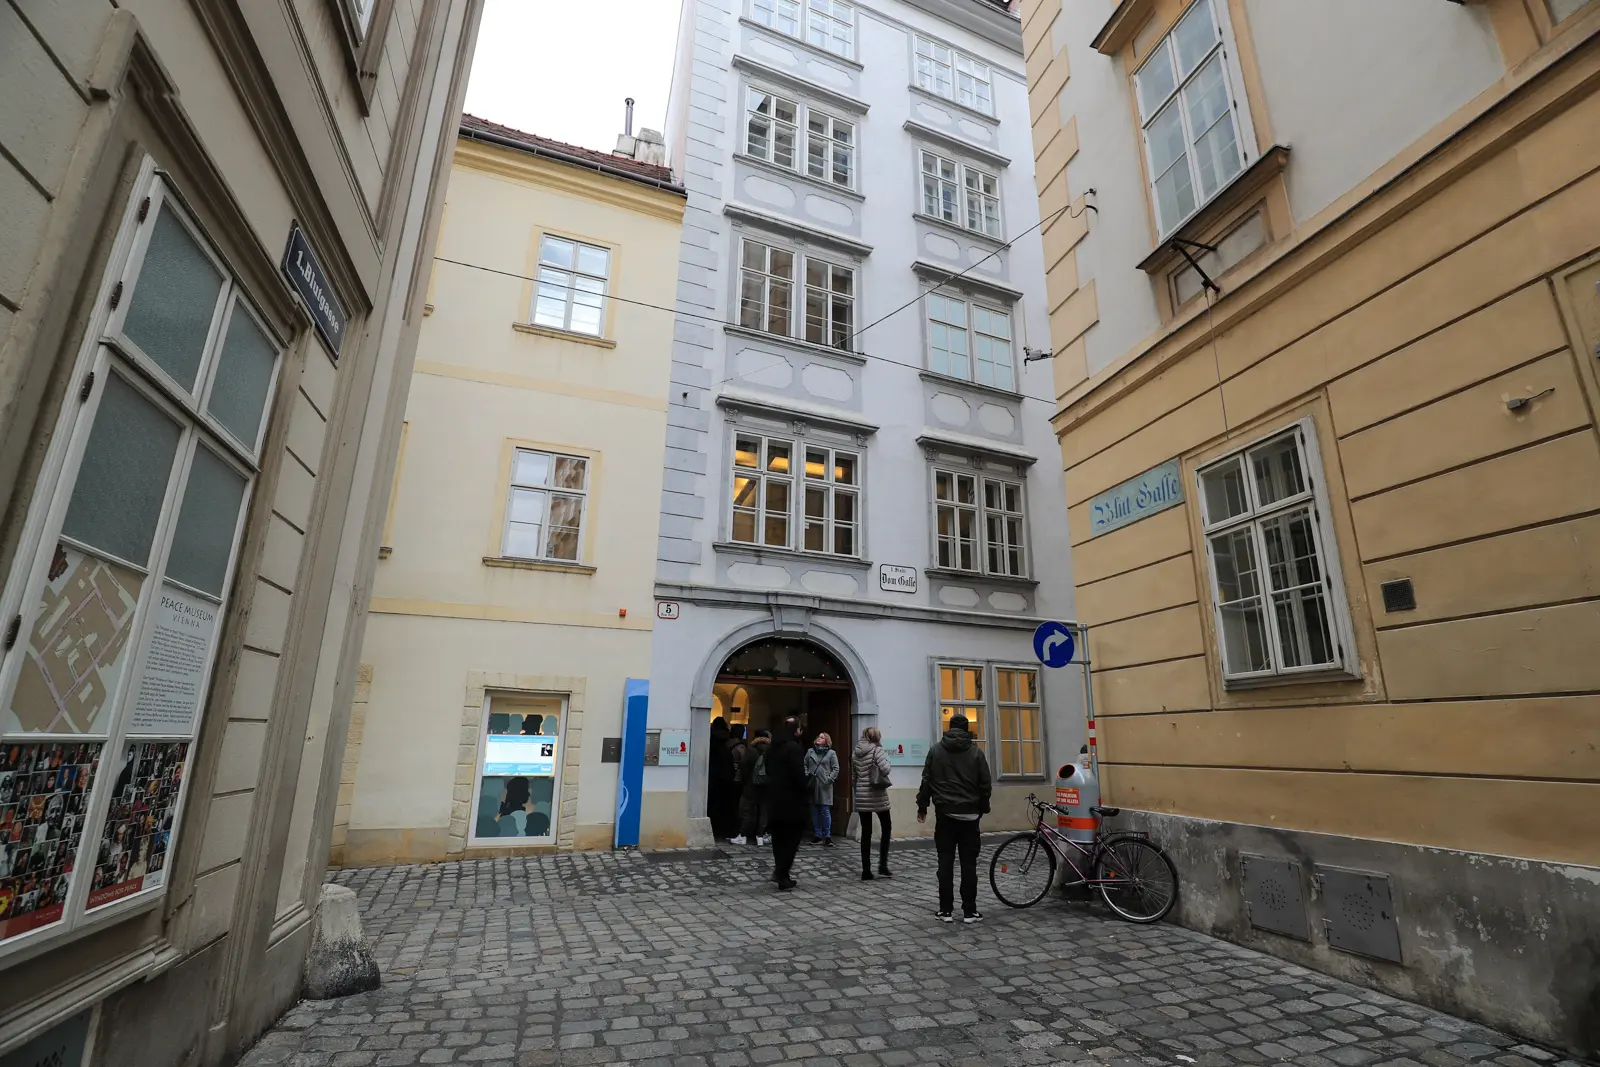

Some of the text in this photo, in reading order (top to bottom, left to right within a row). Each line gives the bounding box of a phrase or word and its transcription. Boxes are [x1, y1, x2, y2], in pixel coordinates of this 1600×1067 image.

[303, 261, 339, 333] Blutgasse
[1094, 495, 1131, 525] Blut
[881, 572, 897, 584] Dom
[160, 596, 214, 622] PEACE MUSEUM
[665, 603, 672, 614] 5
[172, 614, 200, 629] VIENNA
[90, 890, 115, 903] WINDOWS
